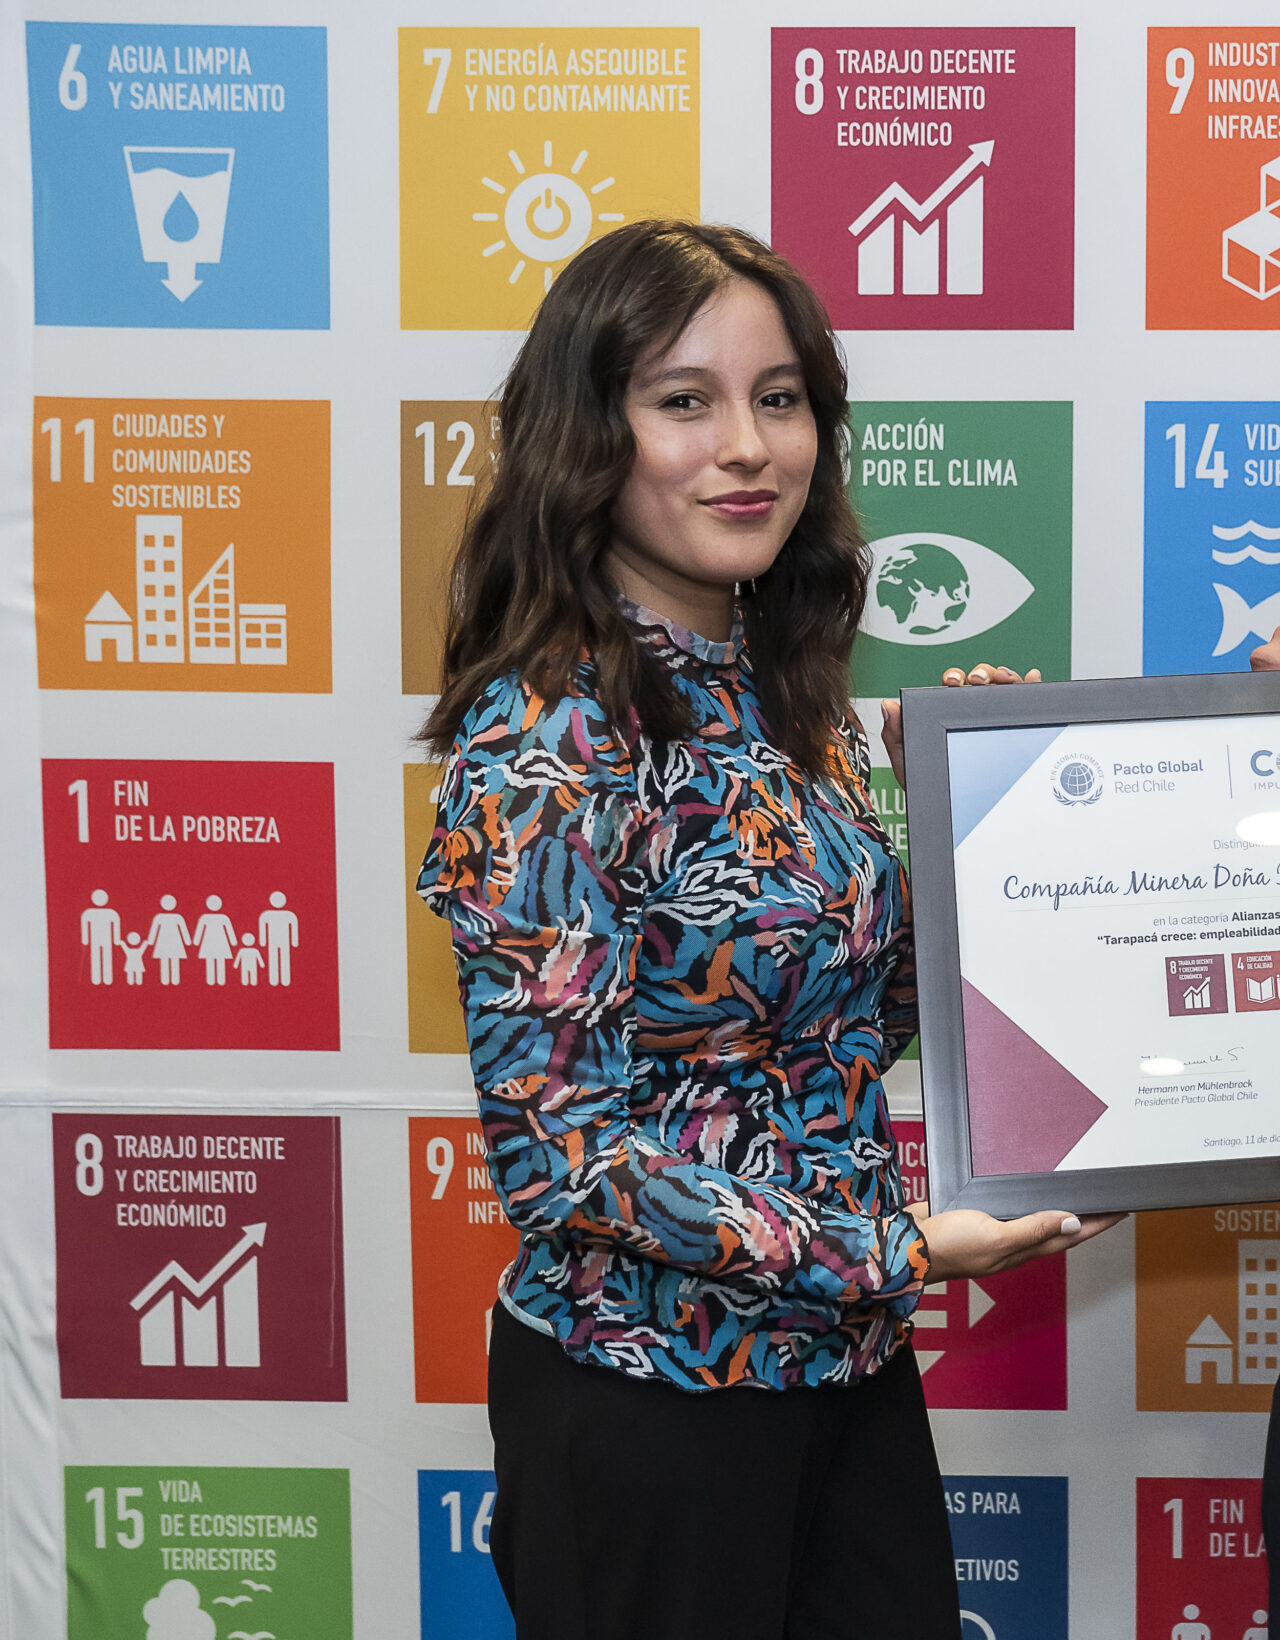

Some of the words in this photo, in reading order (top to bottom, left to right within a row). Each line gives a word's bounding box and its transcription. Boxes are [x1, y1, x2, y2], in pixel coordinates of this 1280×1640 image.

[108, 46, 168, 73] AGUA
[175, 47, 251, 75] LIMPIA
[466, 43, 559, 75] ENERGÍA
[566, 48, 686, 75] ASEQUIBLE
[836, 50, 922, 73] TRABAJO
[931, 50, 1015, 73] DECENTE
[59, 44, 87, 110] 6
[424, 48, 451, 113] 7
[795, 48, 823, 114] 8
[1166, 48, 1194, 114] 9
[109, 82, 122, 109] Y
[130, 82, 284, 112] SANEAMIENTO
[465, 85, 478, 111] Y
[486, 84, 515, 111] NO
[524, 85, 690, 111] CONTAMINANTE
[837, 86, 849, 109] Y
[856, 86, 985, 110] CRECIMIENTO
[838, 117, 951, 146] ECONÓMICO
[113, 414, 206, 438] CIUDADES
[213, 415, 224, 438] Y
[862, 418, 943, 450] ACCIÓN
[42, 418, 94, 482] 11
[113, 449, 251, 473] COMUNIDADES
[416, 421, 474, 485] 12
[1166, 424, 1228, 488] 14
[863, 459, 906, 486] POR
[915, 459, 940, 486] EL
[948, 459, 1017, 486] CLIMA
[113, 484, 240, 508] SOSTENIBLES
[1113, 763, 1153, 776] Pacto
[1158, 759, 1204, 773] Global
[114, 780, 148, 806] FIN
[1114, 781, 1139, 793] Red
[1143, 779, 1175, 792] Chile
[69, 780, 89, 842] 1
[115, 815, 142, 841] DE
[150, 816, 176, 841] LA
[183, 816, 280, 842] POBREZA
[1004, 875, 1119, 911] Compañía
[1123, 870, 1208, 896] Minera
[1213, 863, 1270, 889] Doña
[1153, 918, 1166, 927] en
[1168, 916, 1178, 925] la
[1181, 913, 1229, 926] categoría
[1160, 932, 1197, 942] crece:
[1200, 925, 1280, 940] empleabilidad
[1135, 1096, 1180, 1107] Presidente
[1182, 1094, 1206, 1104] Pacto
[1207, 1092, 1234, 1102] Global
[1237, 1091, 1259, 1100] Chile
[1138, 1085, 1178, 1095] Hermann
[1180, 1084, 1195, 1092] von
[1197, 1080, 1253, 1091] Mühlenbrock
[114, 1135, 196, 1158] TRABAJO
[204, 1136, 285, 1159] DECENTE
[1245, 1135, 1255, 1145] 11
[1257, 1135, 1268, 1144] de
[76, 1133, 103, 1196] 8
[427, 1137, 454, 1199] 9
[115, 1170, 127, 1191] Y
[133, 1170, 256, 1193] CRECIMIENTO
[117, 1200, 226, 1227] ECONÓMICO
[159, 1480, 202, 1502] VIDA
[973, 1492, 1020, 1514] PARA
[86, 1488, 144, 1548] 15
[441, 1491, 496, 1553] 16
[1210, 1499, 1243, 1523] FIN
[161, 1514, 184, 1536] DE
[190, 1514, 317, 1538] ECOSISTEMAS
[1164, 1499, 1182, 1558] 1
[1210, 1533, 1236, 1557] DE
[160, 1548, 276, 1571] TERRESTRES
